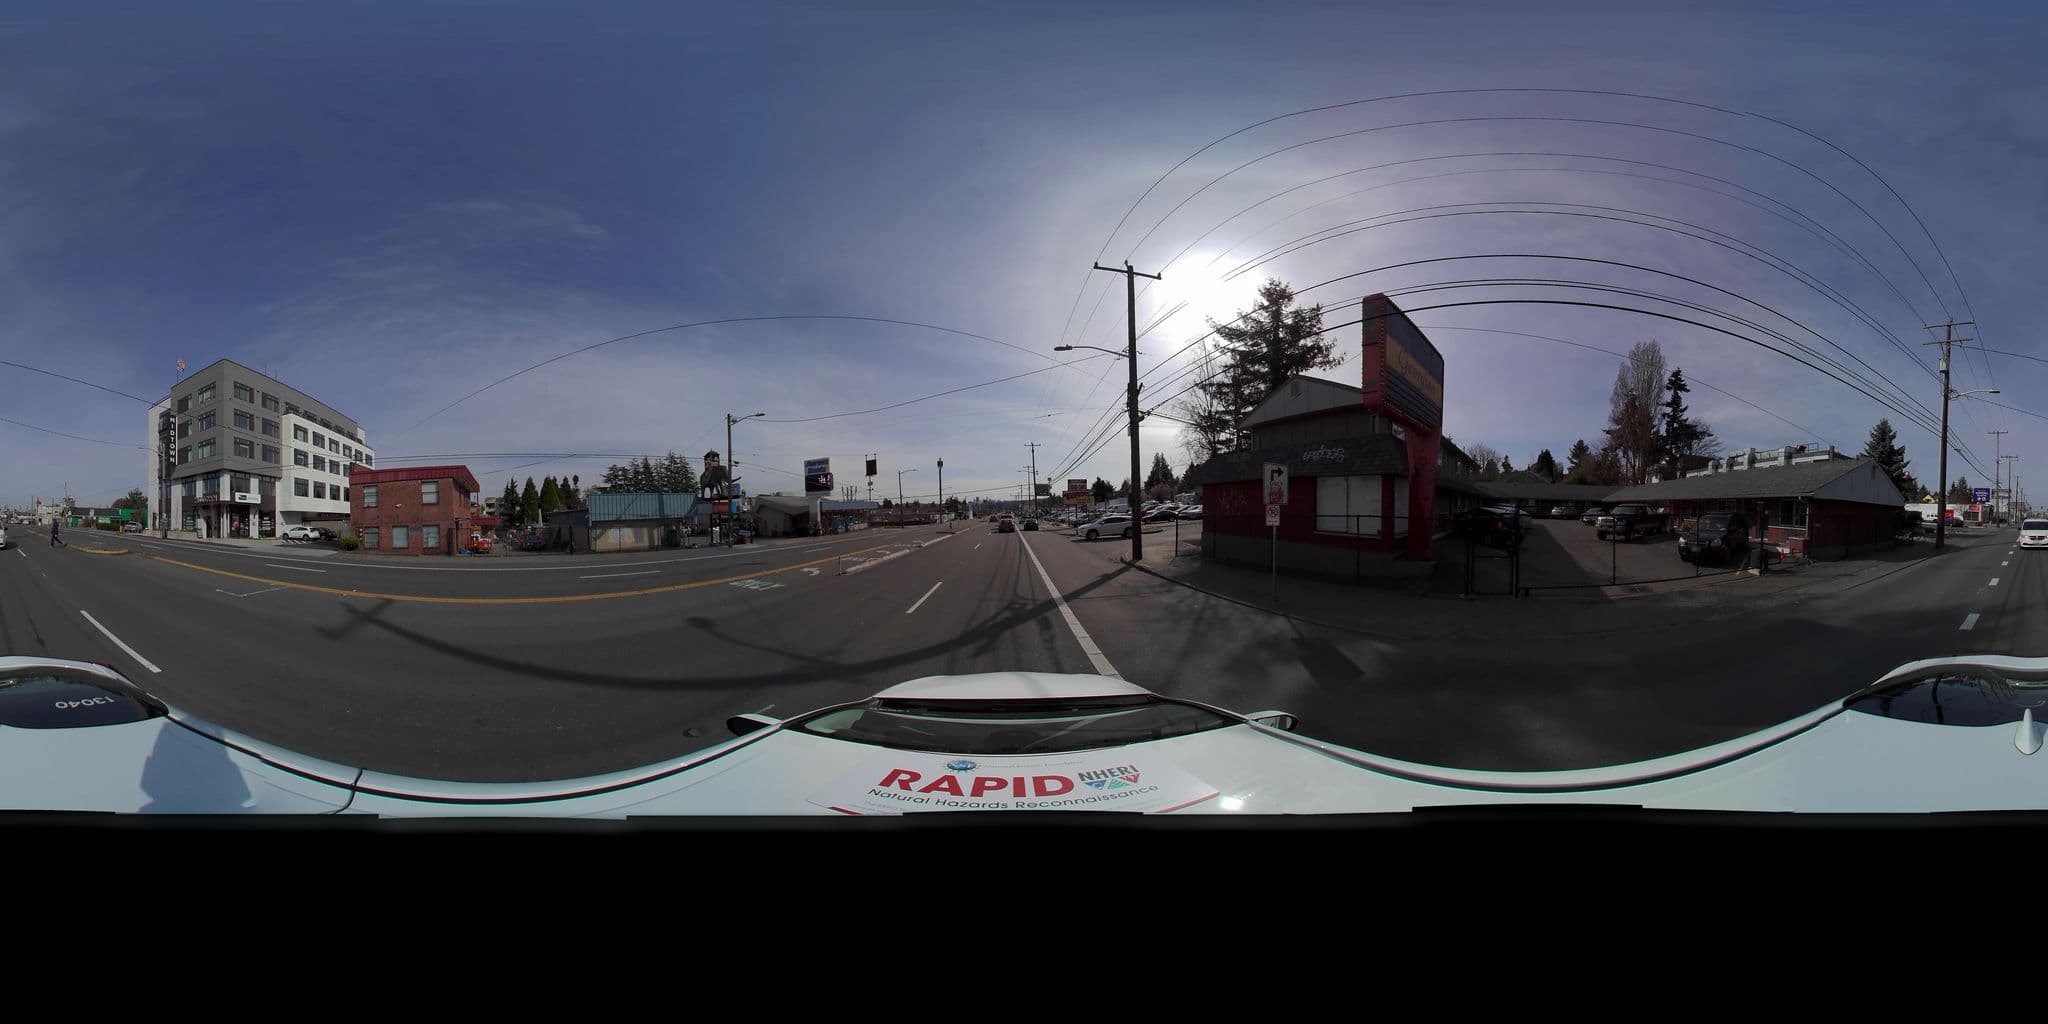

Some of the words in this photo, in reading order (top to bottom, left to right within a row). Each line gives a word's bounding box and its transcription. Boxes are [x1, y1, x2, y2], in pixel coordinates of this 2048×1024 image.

[55, 696, 115, 709] 13040
[878, 768, 1075, 798] RAPID
[1077, 764, 1140, 783] NHERI
[867, 787, 930, 805] Natural
[935, 799, 1009, 810] Hazards
[1015, 784, 1160, 810] Reconnaissance
